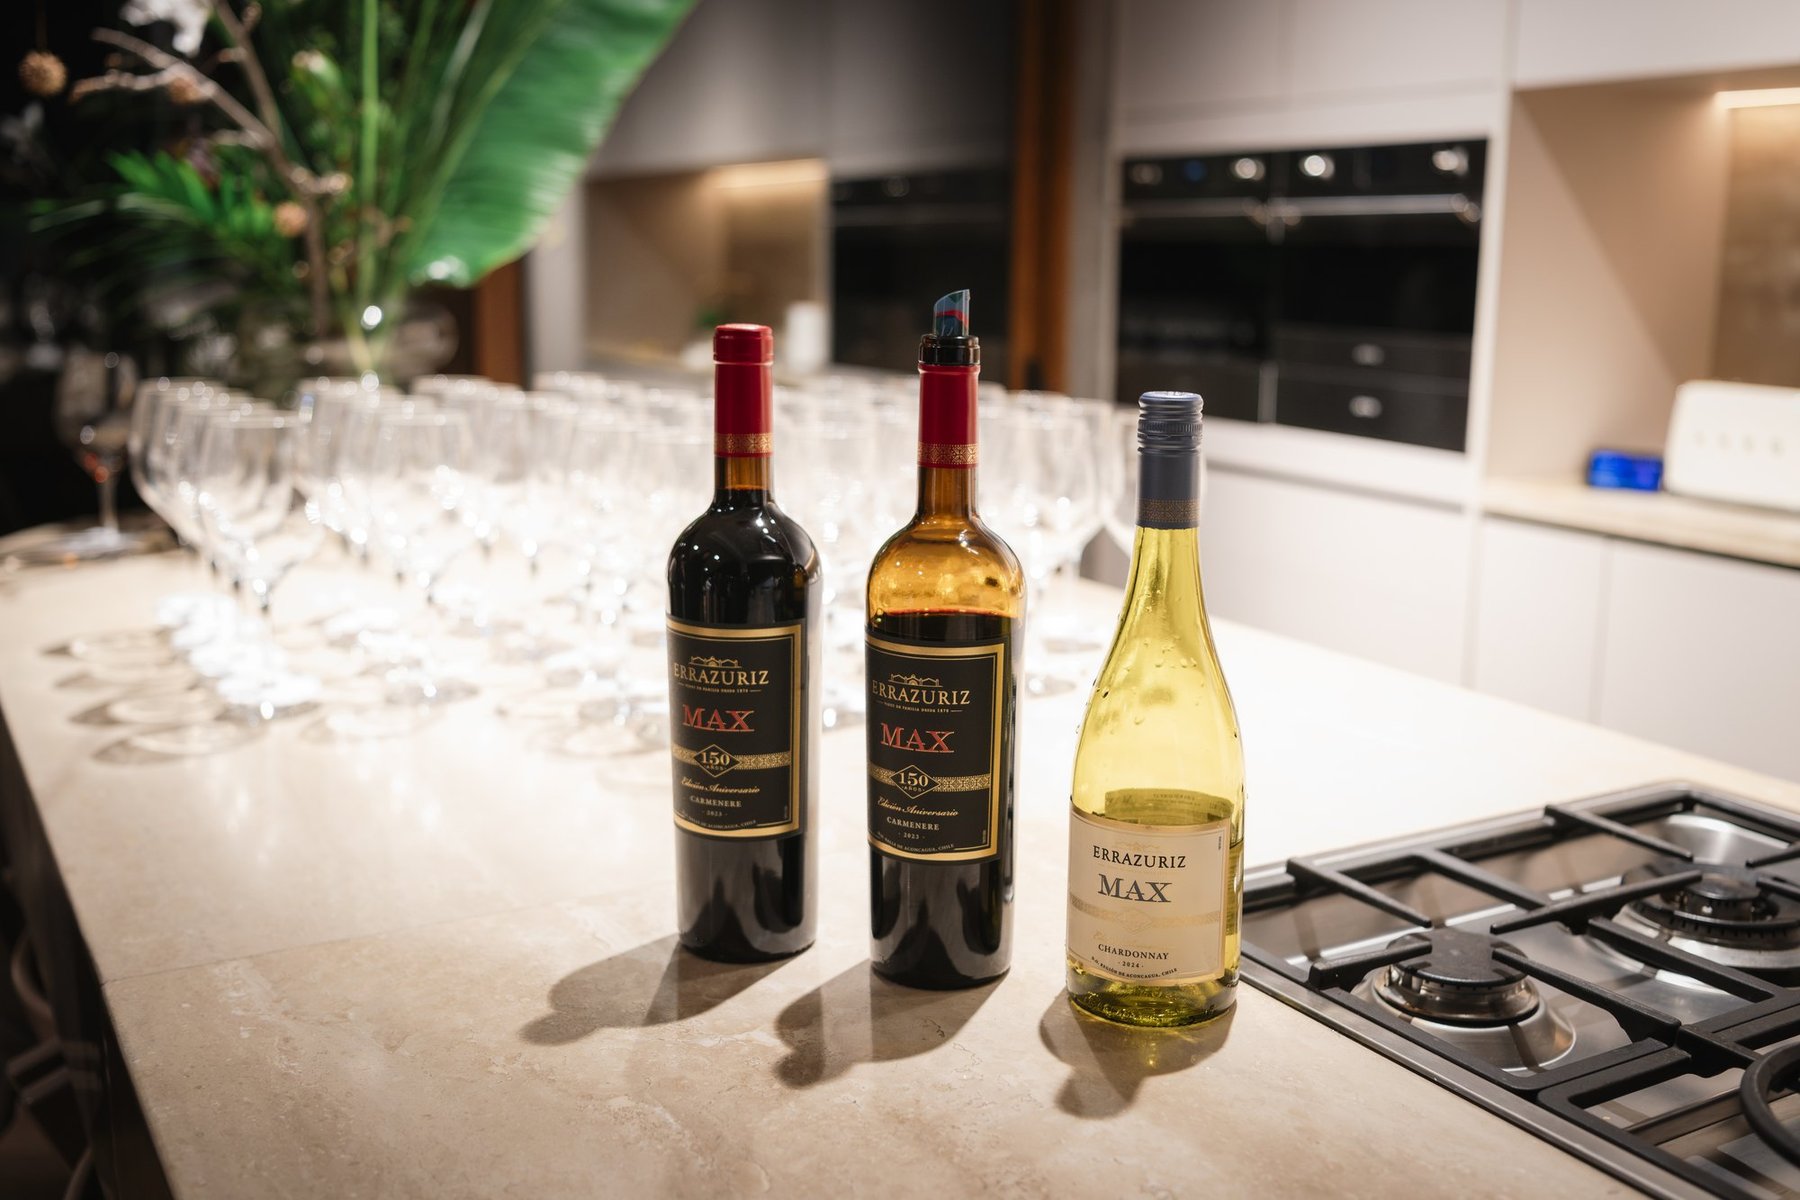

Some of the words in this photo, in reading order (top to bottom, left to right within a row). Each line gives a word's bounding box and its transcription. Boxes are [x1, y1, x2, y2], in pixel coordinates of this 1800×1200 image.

[674, 662, 769, 686] ERRAZURIZ
[872, 679, 971, 706] ERRAZURIZ
[682, 703, 755, 733] MAX
[880, 722, 955, 754] MAX
[701, 751, 731, 766] 150
[899, 771, 929, 787] 150
[704, 783, 760, 794] Aniversario
[690, 795, 742, 808] CARMENERE
[902, 804, 959, 817] Aniversario
[886, 816, 940, 831] CARMENERE
[903, 831, 920, 840] 2023
[1093, 845, 1187, 869] ERRAZURIZ
[1098, 873, 1172, 903] MAX
[1098, 943, 1169, 960] CHARDONNAY
[1161, 967, 1178, 977] CHILE
